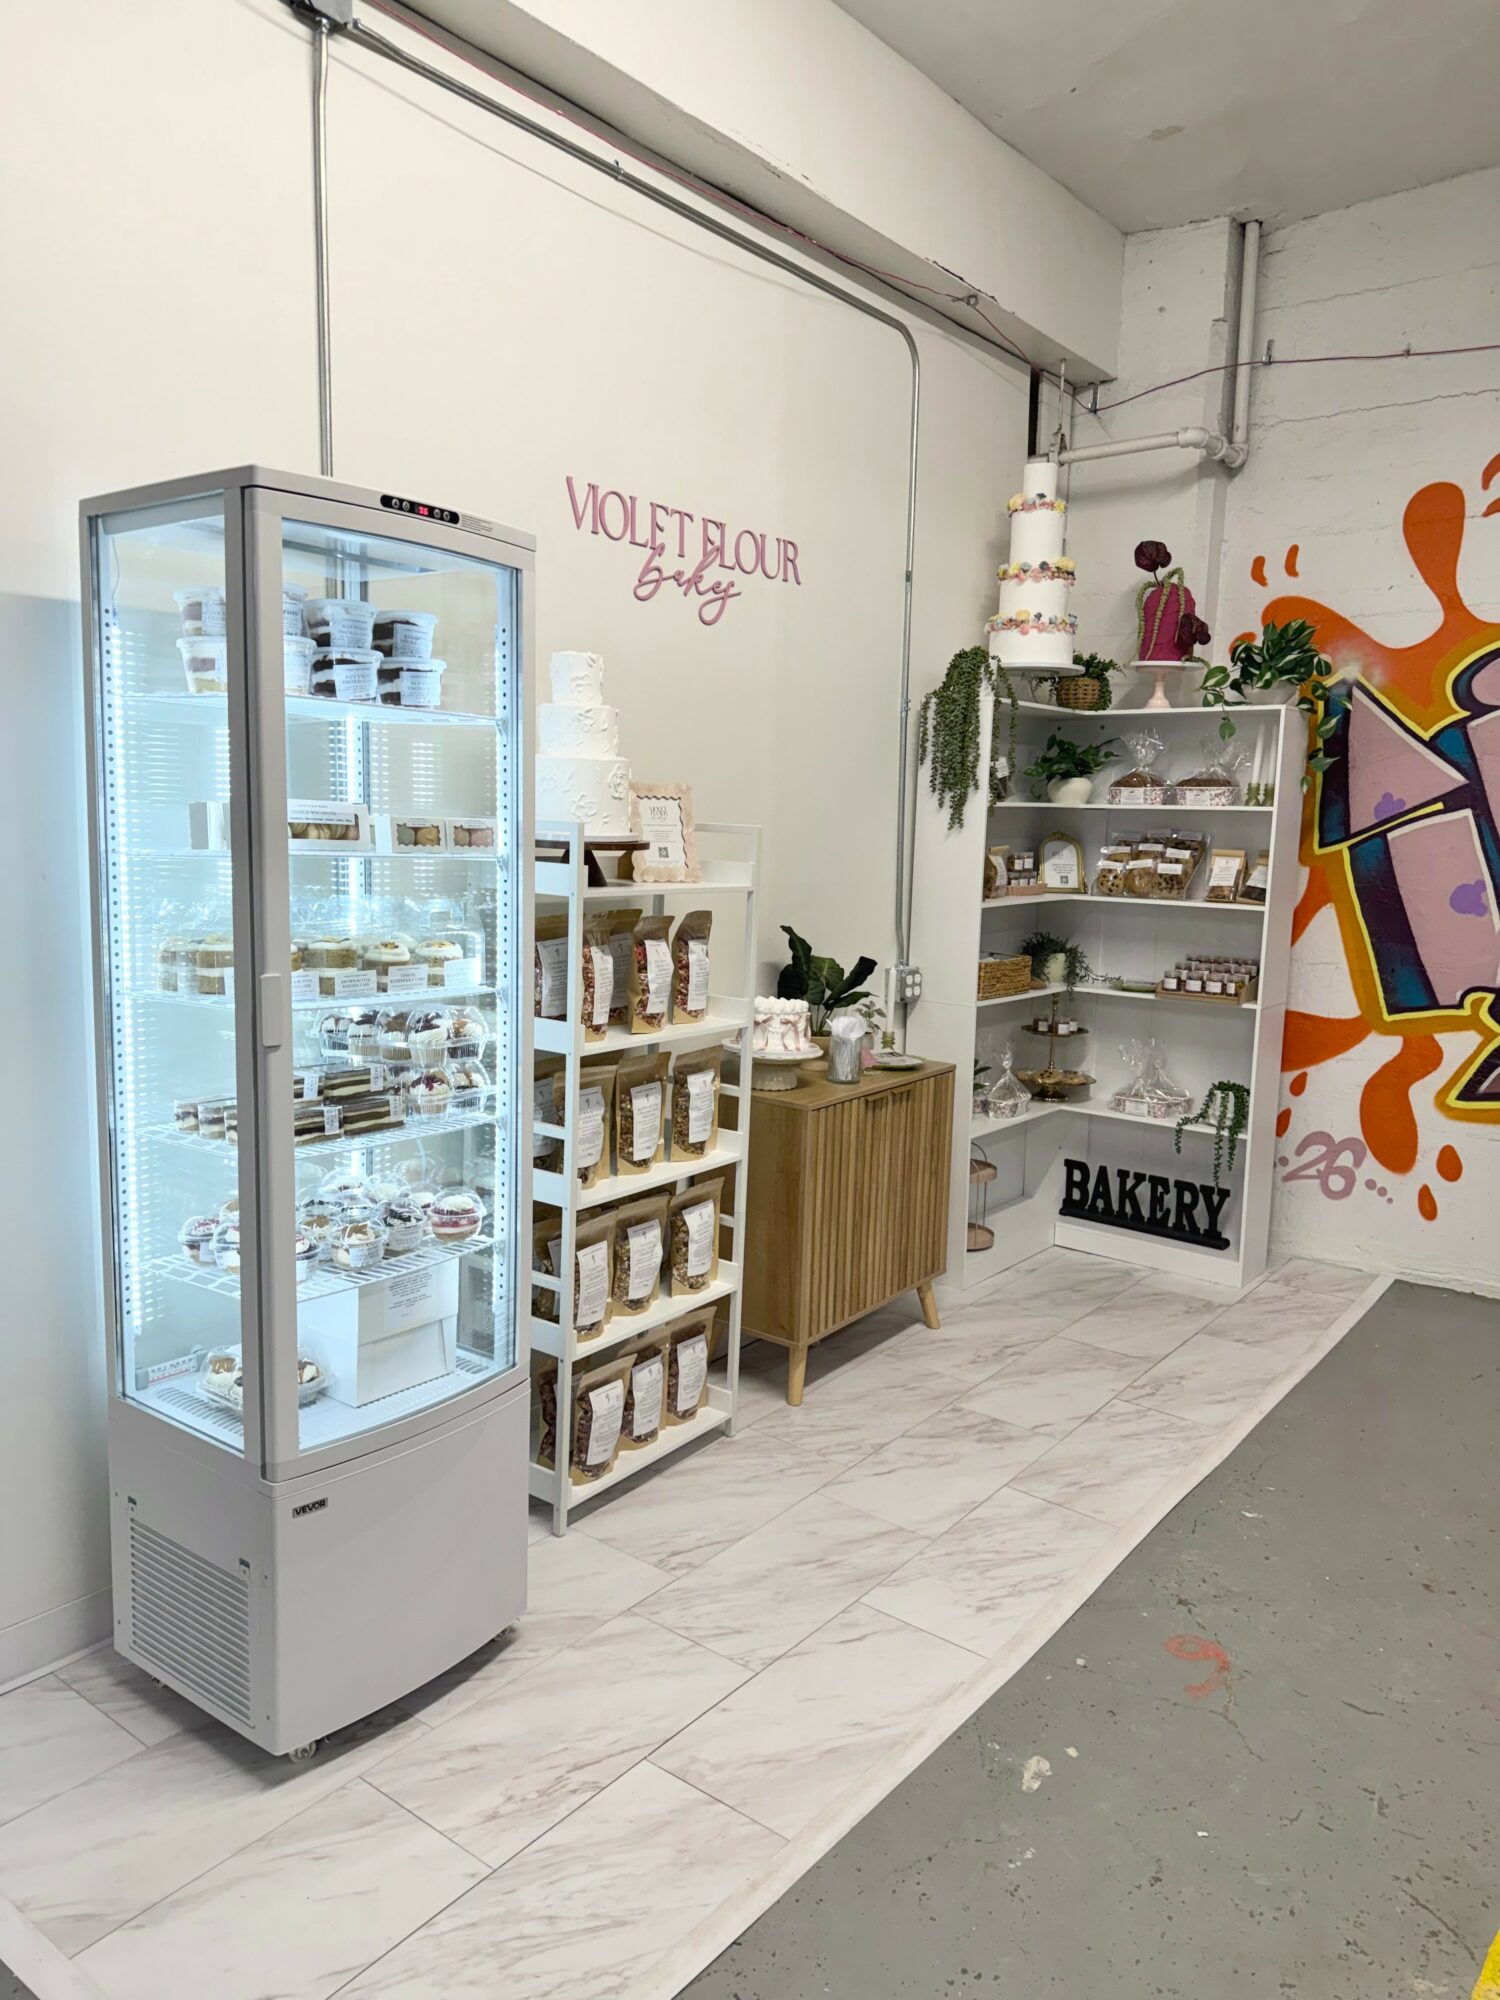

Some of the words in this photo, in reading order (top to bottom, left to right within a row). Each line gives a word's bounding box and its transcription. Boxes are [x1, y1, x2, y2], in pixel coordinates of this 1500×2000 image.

[565, 475, 694, 558] VIOLET
[702, 516, 801, 585] FLOUR
[1062, 1158, 1231, 1240] BAKERY
[294, 1499, 326, 1516] VEVOR
